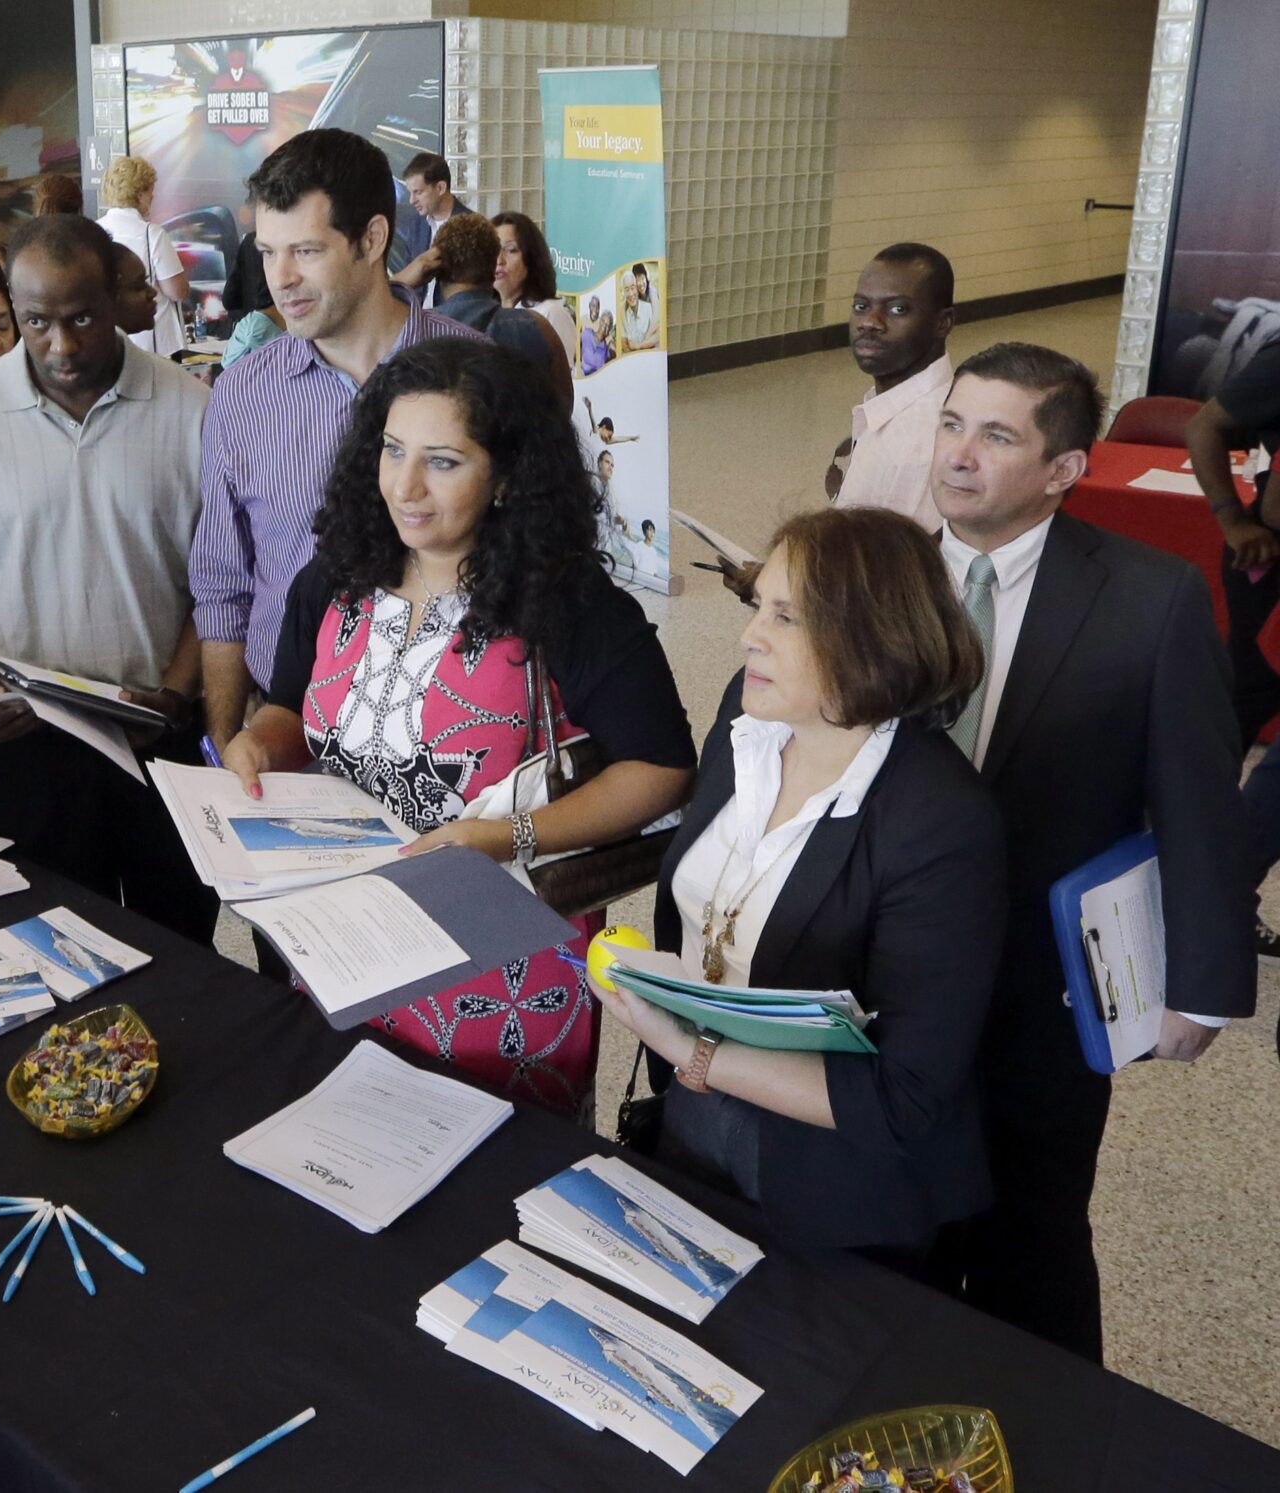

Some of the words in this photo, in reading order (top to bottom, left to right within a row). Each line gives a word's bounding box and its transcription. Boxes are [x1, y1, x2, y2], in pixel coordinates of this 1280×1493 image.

[208, 93, 229, 108] DRIVE
[230, 92, 256, 107] SOBER
[258, 92, 269, 107] OR
[208, 109, 220, 124] GET
[222, 109, 248, 124] PULLED
[250, 109, 269, 124] OVER
[569, 117, 586, 129] Your
[576, 131, 602, 149] Your
[604, 131, 644, 154] legacy.
[588, 168, 618, 179] Educational
[619, 169, 645, 180] Seminars
[273, 919, 303, 951] Carnival
[586, 1228, 640, 1266] HOLIDAY
[560, 1374, 636, 1422] HOLIDAY
